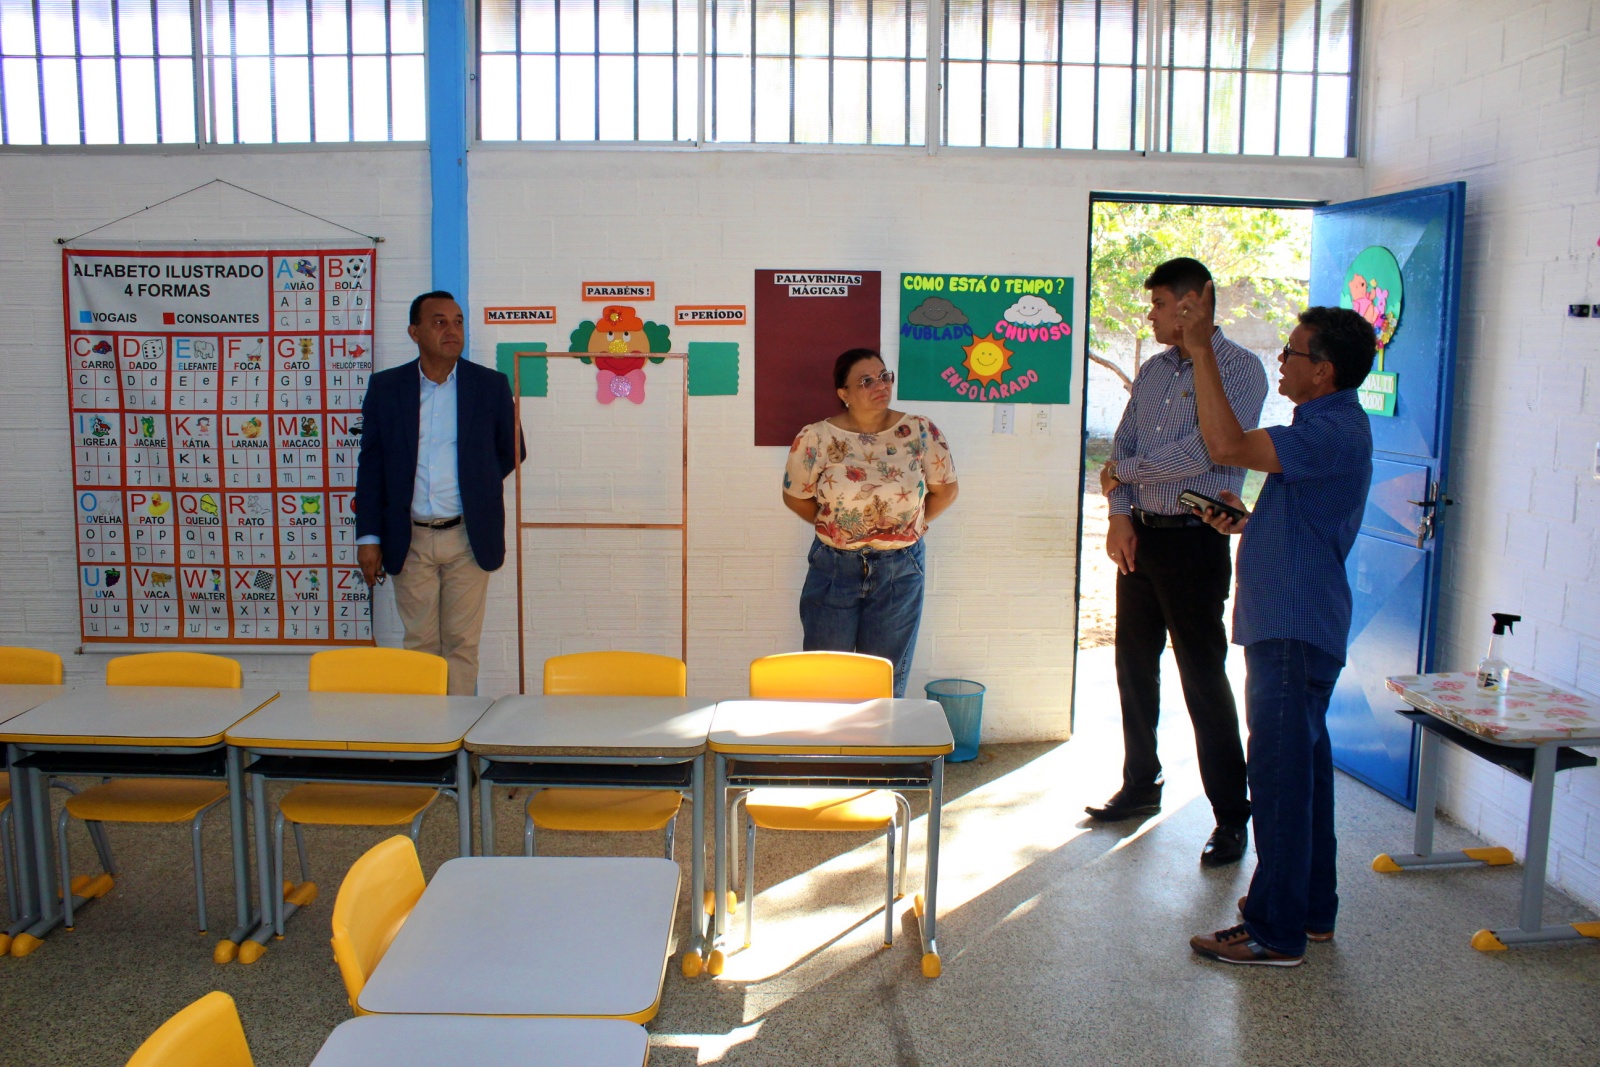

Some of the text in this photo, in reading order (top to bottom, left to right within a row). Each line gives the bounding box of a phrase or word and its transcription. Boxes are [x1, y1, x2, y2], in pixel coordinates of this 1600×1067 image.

[74, 264, 263, 278] ALFABETO ILUSTRADO
[276, 259, 293, 278] A
[329, 259, 343, 277] B
[777, 275, 860, 284] PALAVRINHAS
[904, 276, 944, 291] COMO
[949, 275, 987, 293] ESTÁ
[990, 278, 1000, 293] O
[125, 284, 210, 297] 4 FORMAS
[284, 281, 314, 290] AVIÃO
[792, 284, 845, 295] MÁGICAS
[281, 297, 289, 307] A
[333, 296, 363, 305] B b
[93, 313, 259, 323] VOGAIS CONSOANTES
[488, 311, 552, 319] MATERNAL
[692, 309, 742, 319] PERÍODO
[900, 323, 973, 341] NUBLADO
[995, 320, 1071, 342] CHUVOSO
[74, 337, 90, 356] C
[124, 338, 140, 357] D
[176, 339, 191, 358] E
[228, 340, 242, 358] F
[278, 339, 295, 358] G
[330, 338, 346, 357] H
[332, 361, 371, 369] HELICÓPTERO
[80, 375, 88, 384] C
[128, 376, 157, 385] D d
[180, 376, 187, 386] E
[232, 376, 259, 386] F f
[281, 376, 311, 385] G g
[334, 375, 363, 385] H h
[940, 366, 1038, 401] ENSOLARADO
[129, 416, 138, 434] J
[176, 417, 191, 436] K
[227, 417, 239, 436] L
[278, 417, 297, 436] M
[332, 416, 347, 435] N
[134, 438, 166, 447] JACARÉ
[183, 438, 210, 448] KÁTIA
[108, 452, 110, 462] i
[135, 453, 159, 464] J j
[180, 454, 210, 463] K k
[233, 454, 238, 464] L
[284, 454, 293, 463] M
[337, 454, 344, 463] N
[80, 493, 97, 512] O
[131, 494, 146, 512] P
[180, 495, 197, 514] Q
[229, 496, 246, 514] R
[282, 495, 296, 514] S
[333, 495, 348, 513] T
[86, 529, 95, 539] O
[137, 530, 166, 540] P p
[186, 530, 214, 541] Q q
[236, 532, 243, 541] R
[287, 532, 295, 541] S
[339, 531, 346, 540] T
[84, 568, 99, 587] U
[134, 568, 149, 587] V
[184, 570, 207, 588] W
[234, 571, 251, 588] X
[286, 570, 302, 588] Y
[337, 570, 351, 588] Z
[91, 604, 98, 613] U
[141, 604, 148, 614] V
[189, 605, 200, 614] W
[241, 606, 248, 615] X
[291, 606, 320, 615] Y y
[341, 607, 348, 616] Z
